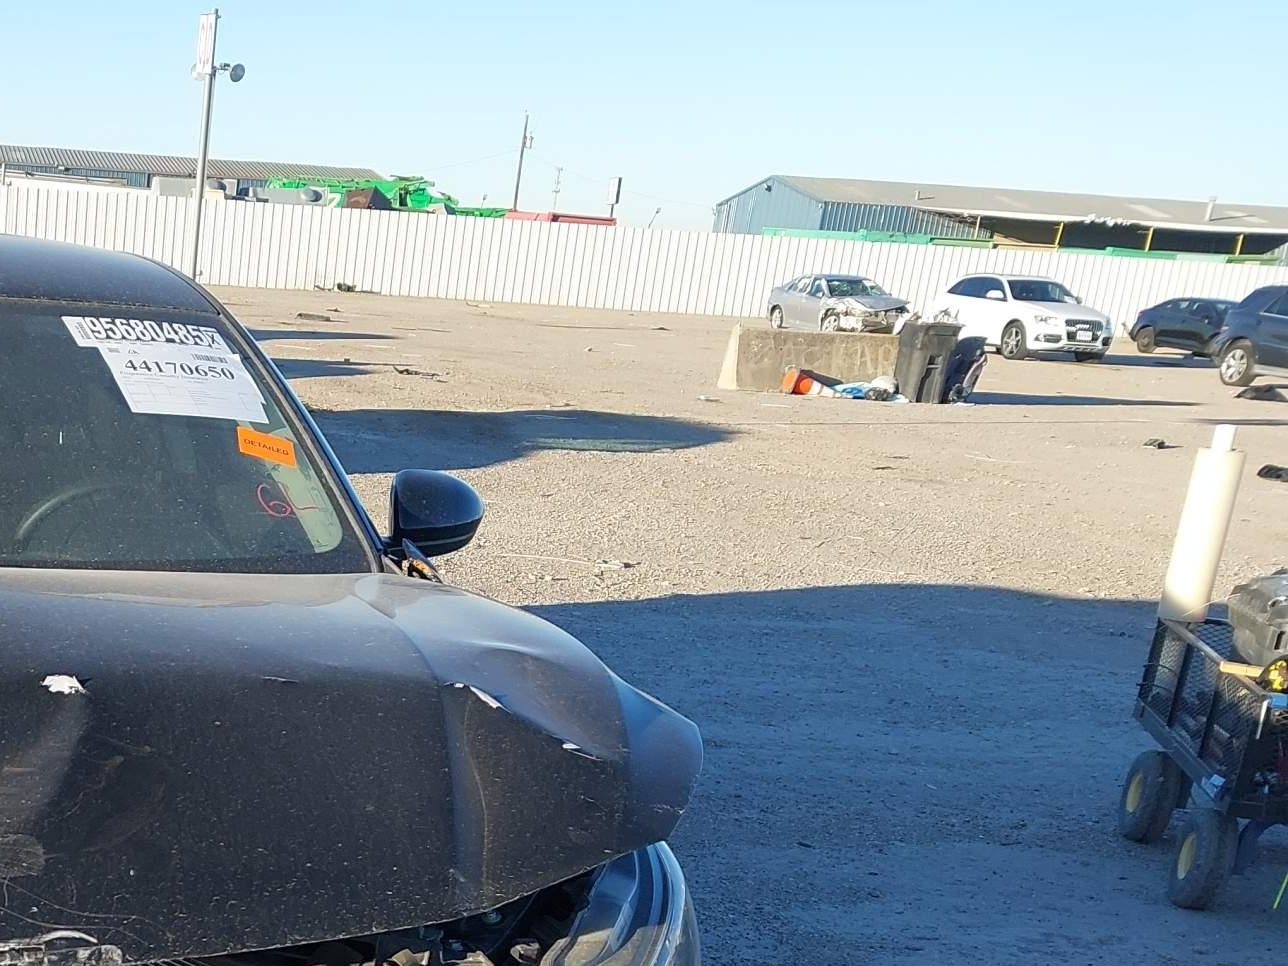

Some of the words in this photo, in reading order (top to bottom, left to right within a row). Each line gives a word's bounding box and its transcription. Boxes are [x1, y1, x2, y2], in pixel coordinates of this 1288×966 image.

[87, 316, 208, 346] 95680485
[124, 358, 235, 380] 44170650
[243, 438, 289, 456] DETAILED
